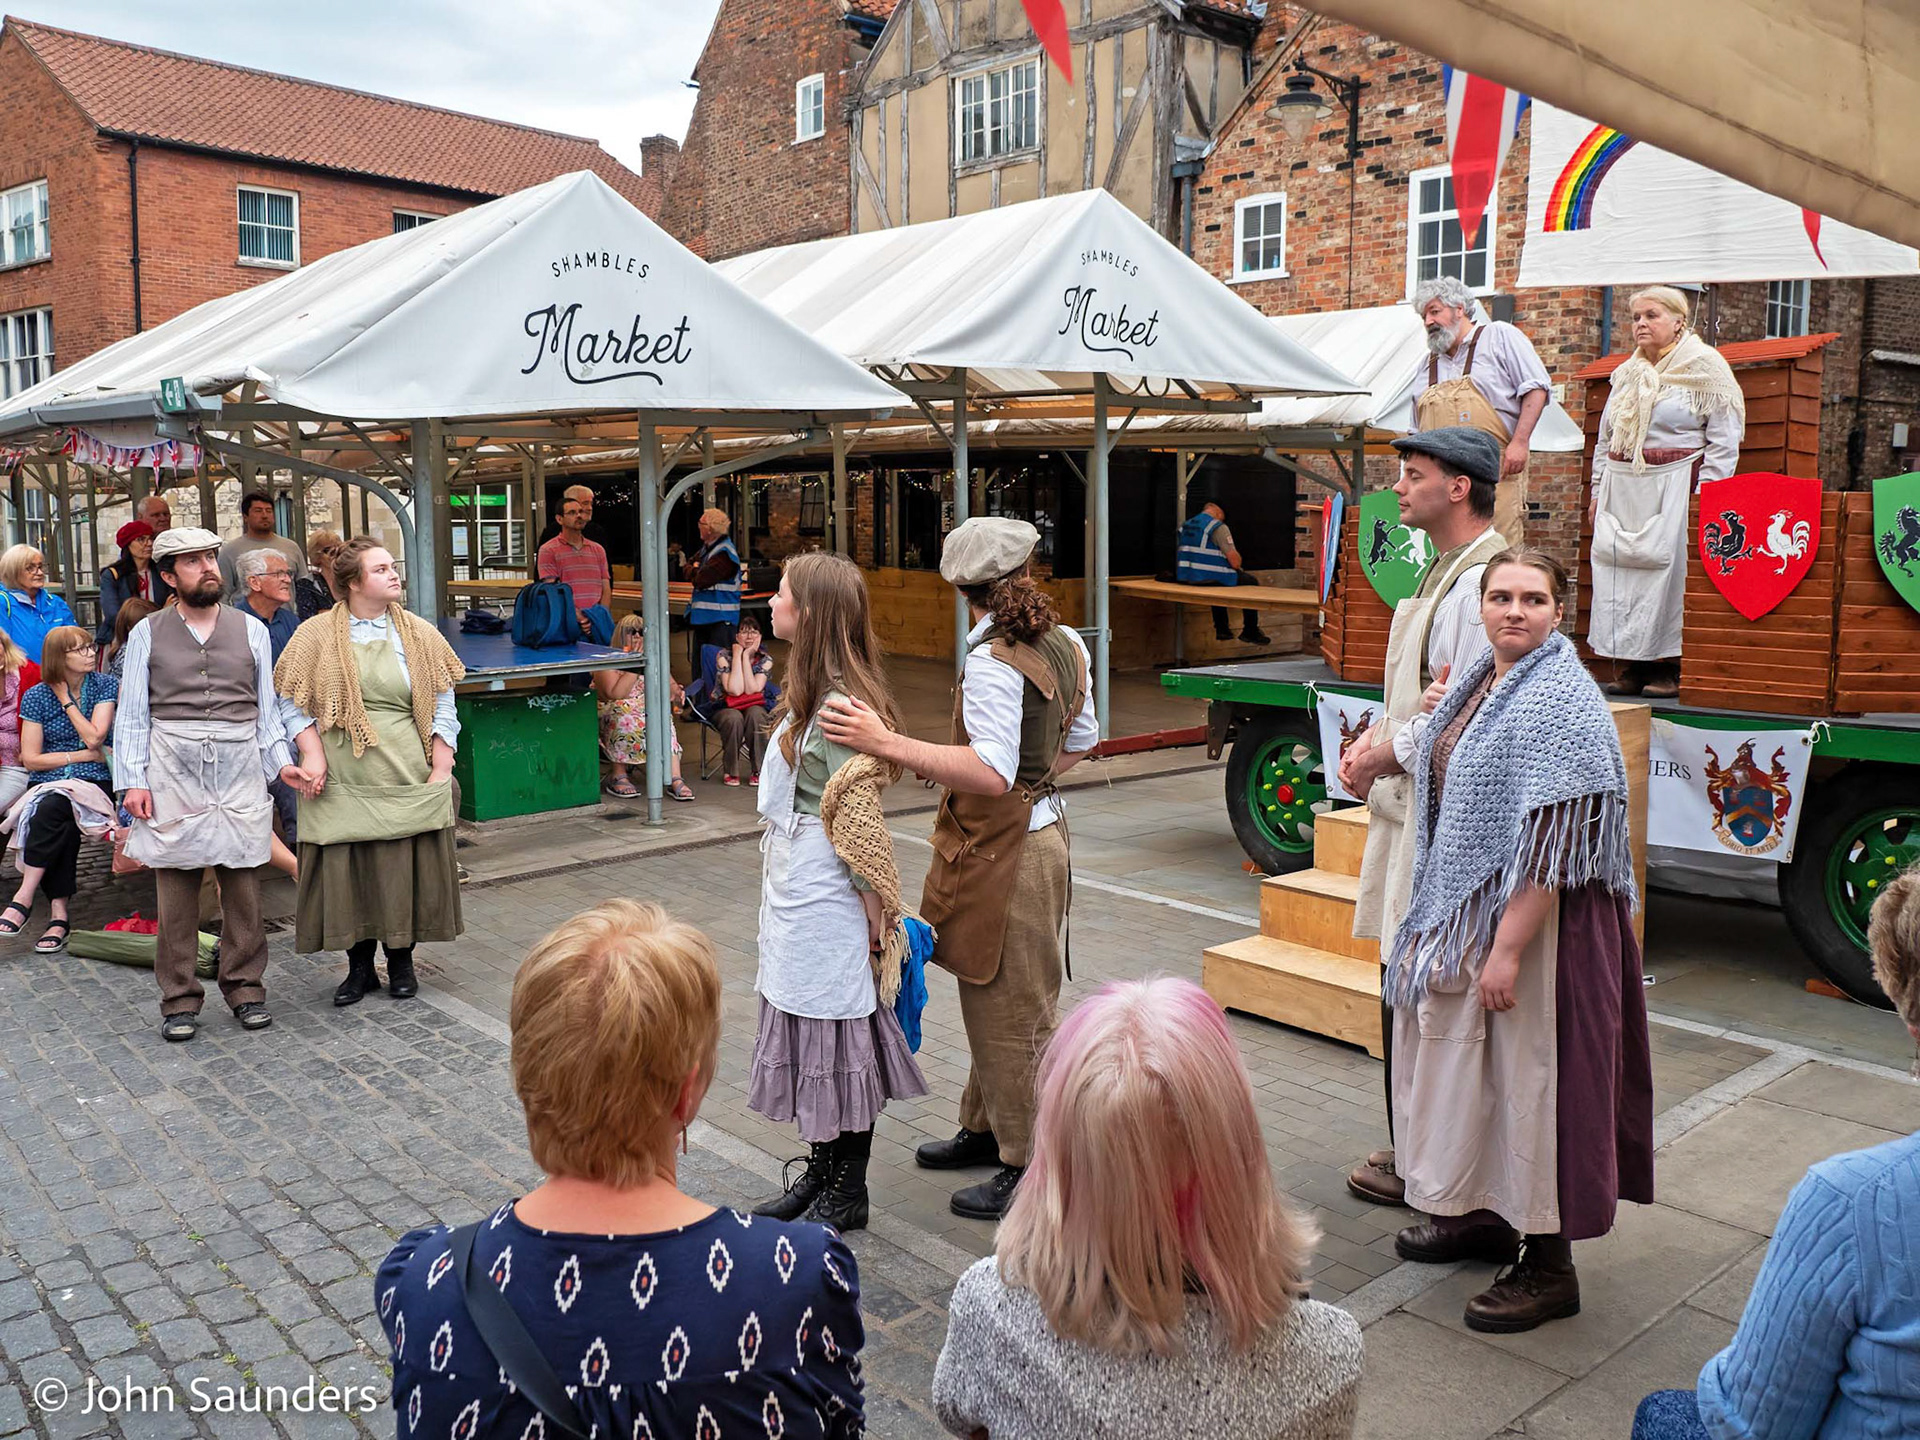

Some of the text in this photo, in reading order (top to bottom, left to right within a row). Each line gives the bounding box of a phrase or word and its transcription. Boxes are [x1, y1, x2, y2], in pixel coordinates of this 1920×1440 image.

[551, 251, 650, 278] SHAMBLES
[1081, 249, 1139, 277] SHAMBLES
[521, 303, 692, 386] Market
[1058, 284, 1159, 362] Market
